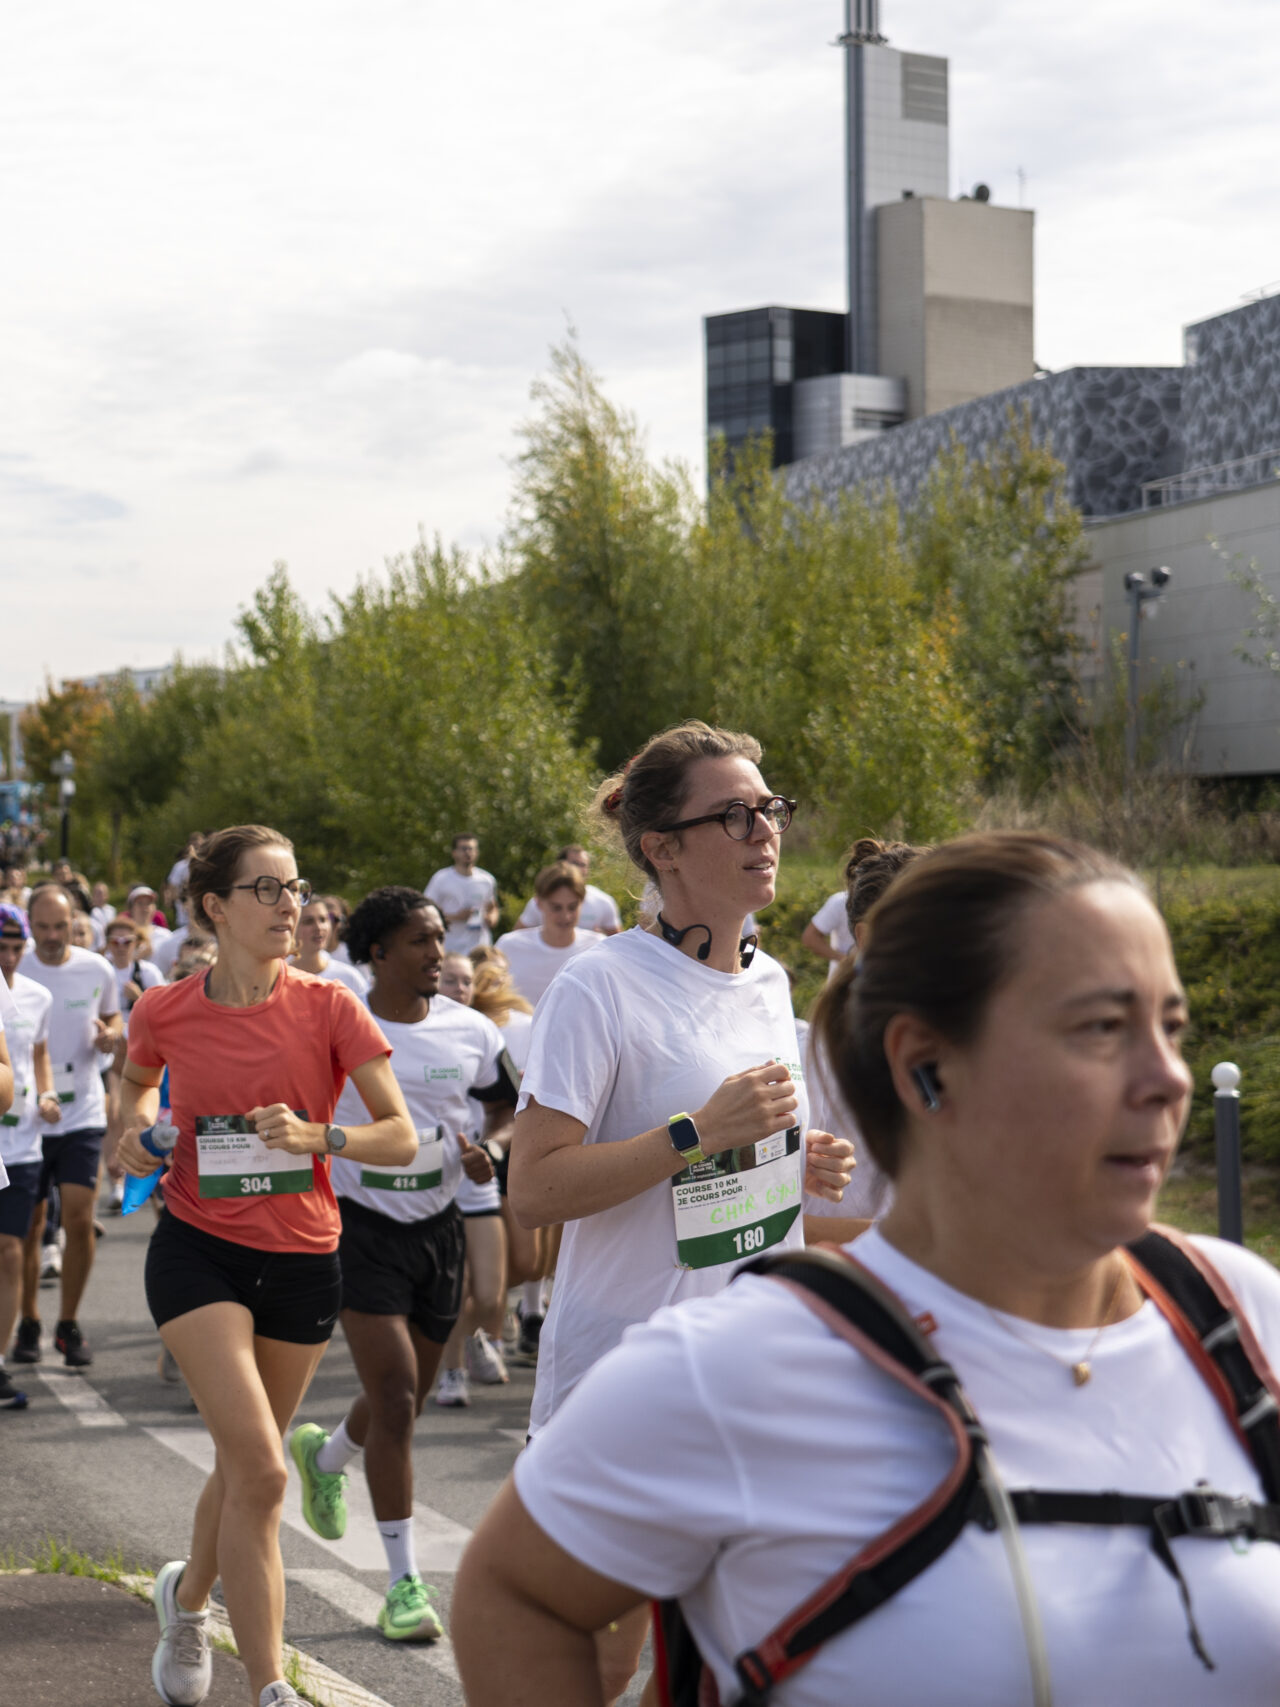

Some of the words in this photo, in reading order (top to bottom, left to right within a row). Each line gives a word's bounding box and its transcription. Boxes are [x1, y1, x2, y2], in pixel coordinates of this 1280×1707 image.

[240, 1176, 272, 1193] 304
[393, 1176, 418, 1189] 414
[676, 1184, 712, 1196] COURSE
[715, 1181, 724, 1189] 10
[726, 1178, 738, 1187] KM
[678, 1198, 688, 1206] JE
[690, 1191, 719, 1203] COURS
[722, 1185, 743, 1197] POUR
[732, 1226, 765, 1254] 180
